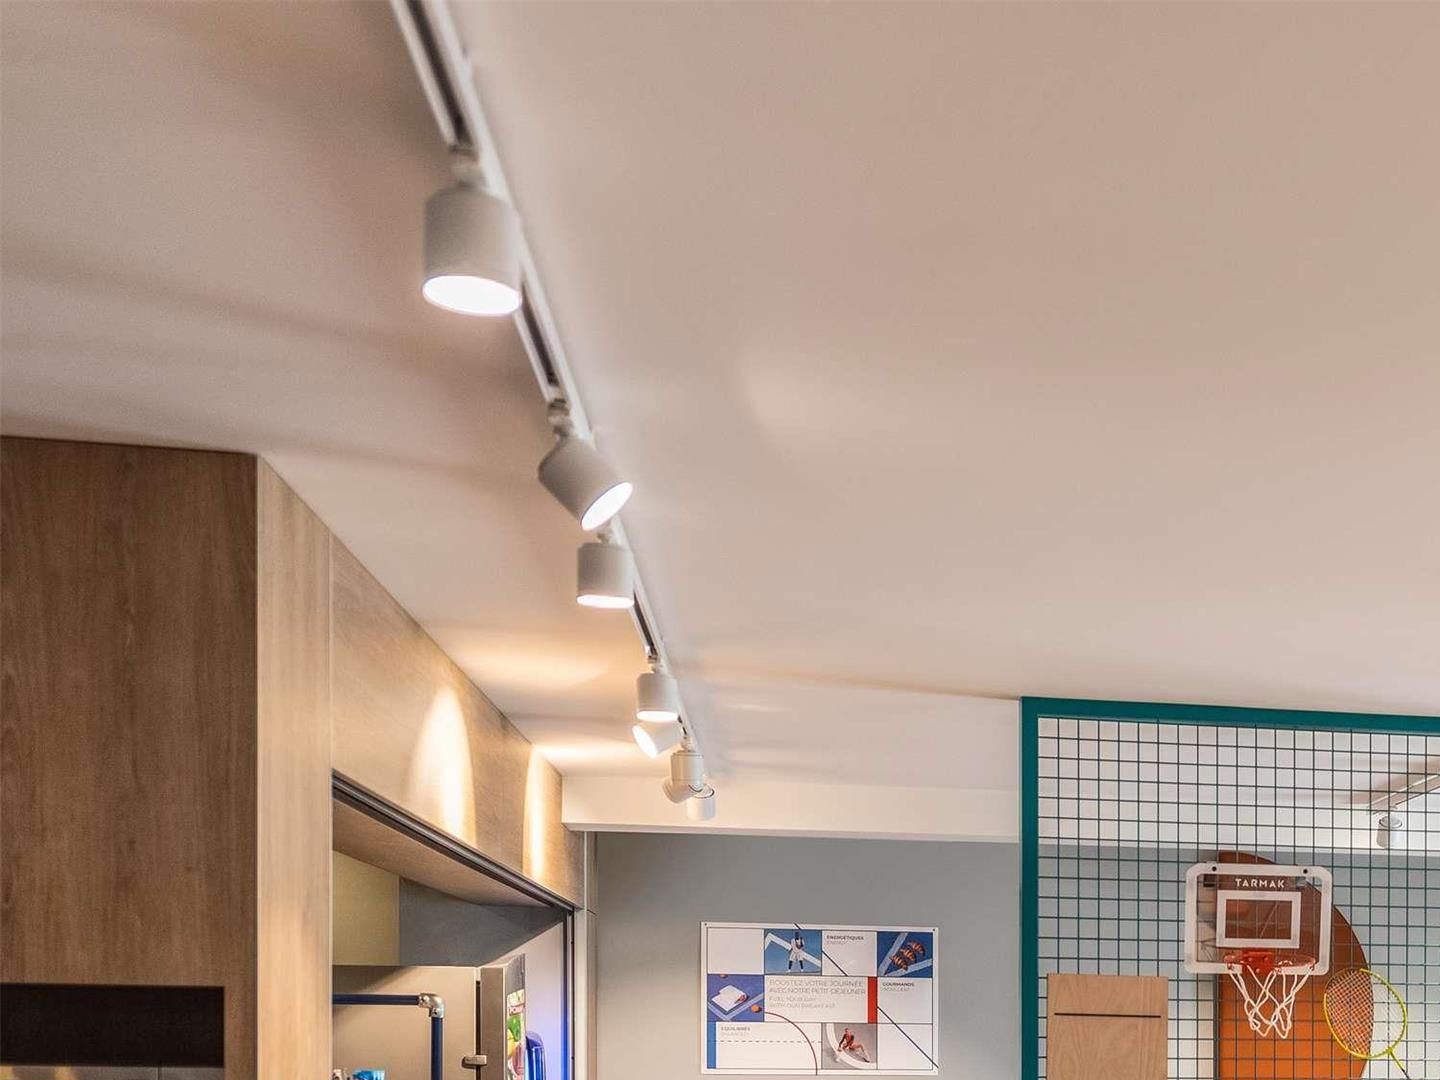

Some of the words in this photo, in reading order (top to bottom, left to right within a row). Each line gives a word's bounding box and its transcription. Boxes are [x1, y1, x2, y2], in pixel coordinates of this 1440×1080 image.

[1235, 878, 1286, 888] TARMAK
[769, 979, 803, 987] BOOSTEZ
[805, 979, 828, 987] VOTRE
